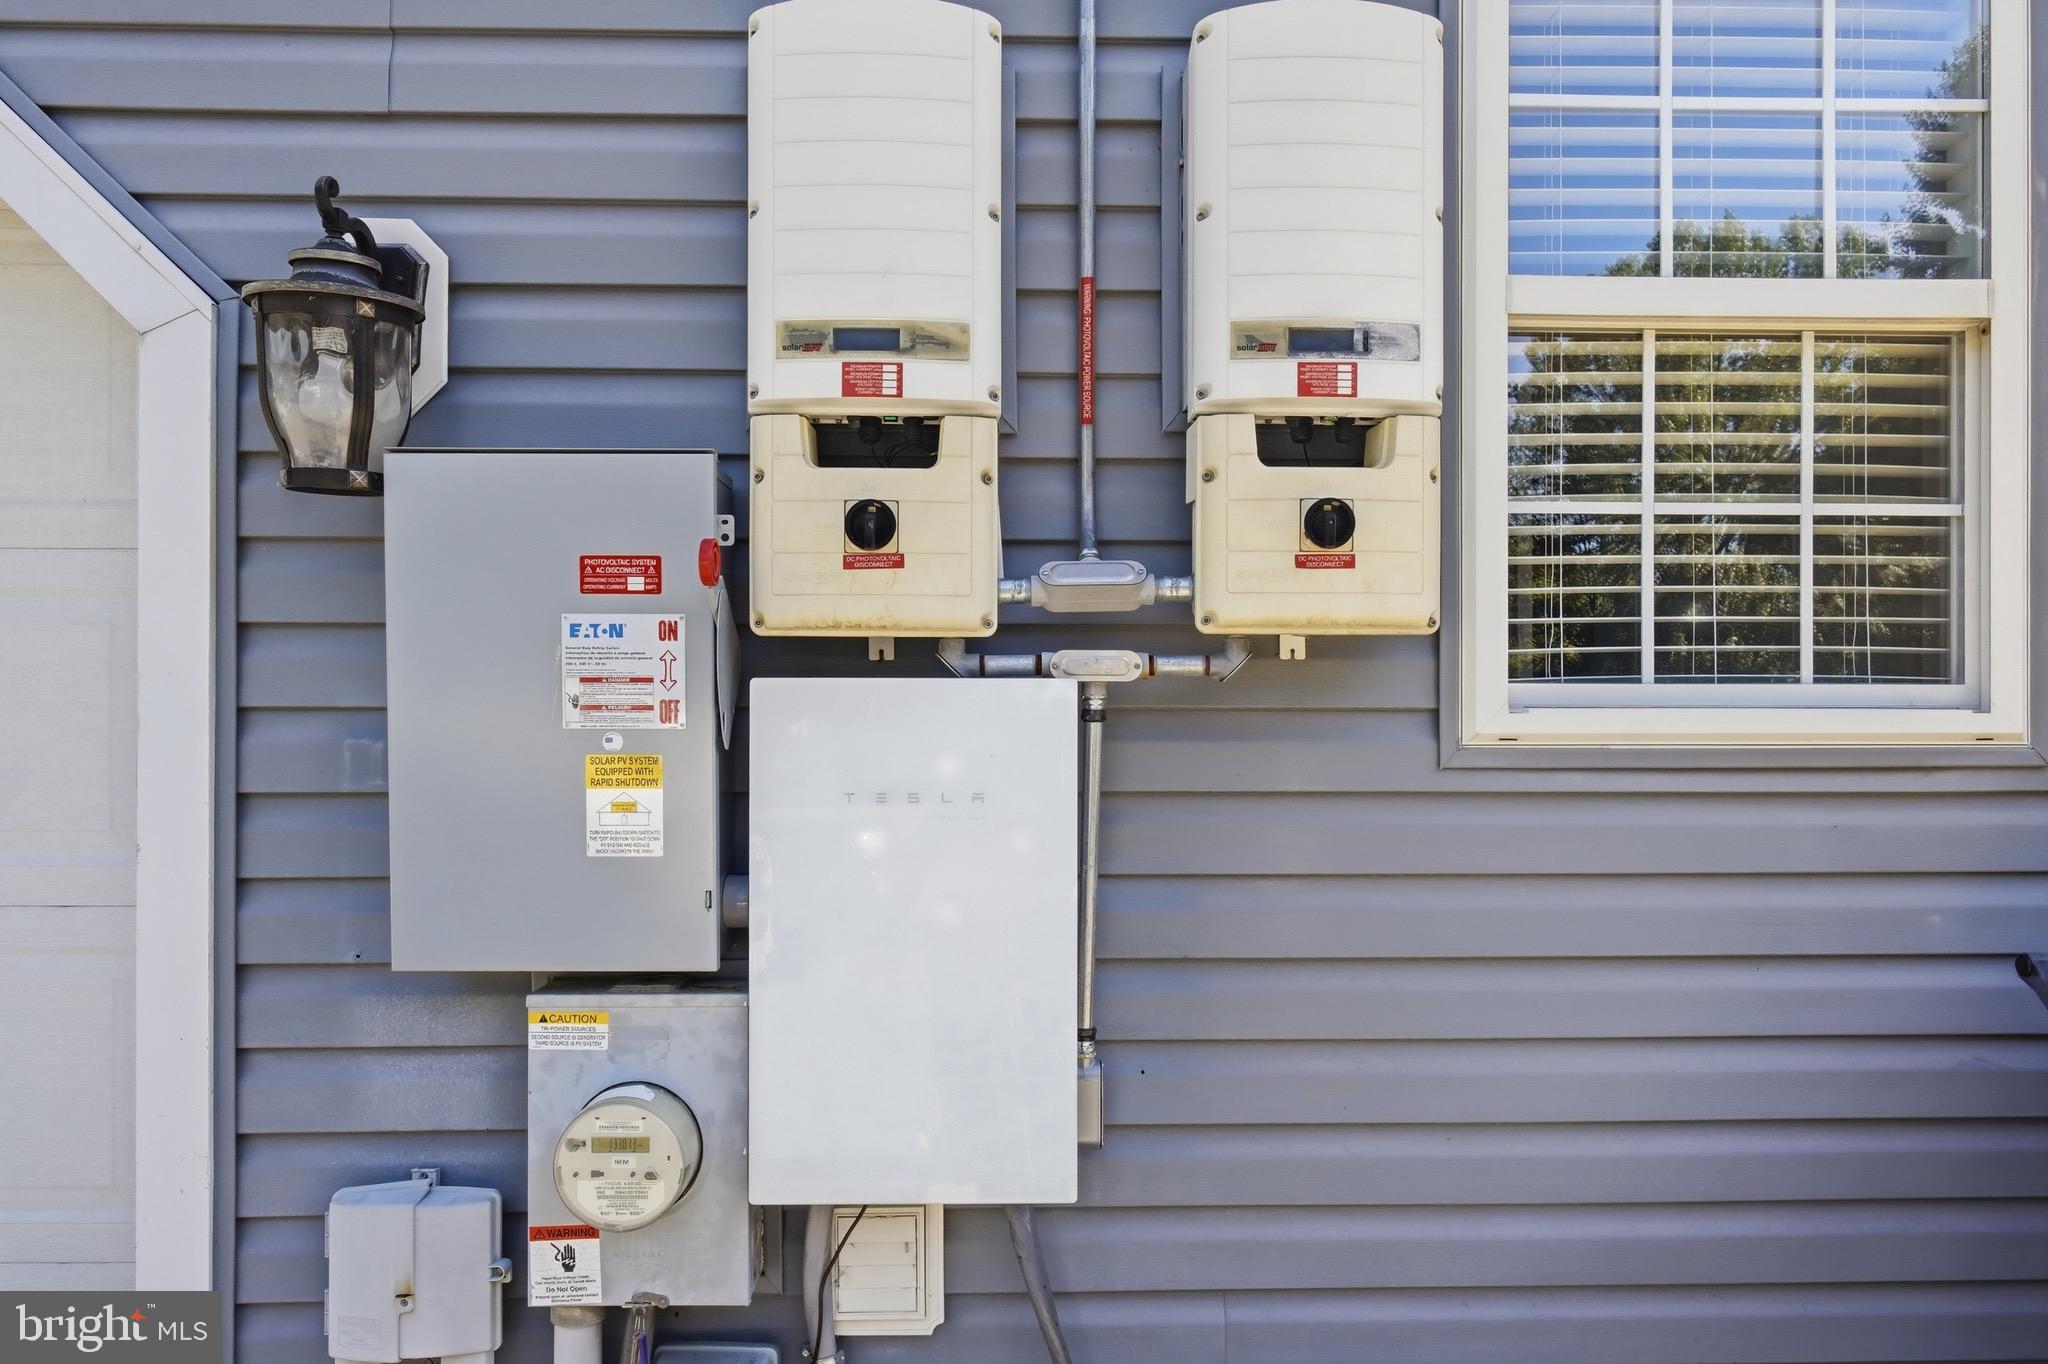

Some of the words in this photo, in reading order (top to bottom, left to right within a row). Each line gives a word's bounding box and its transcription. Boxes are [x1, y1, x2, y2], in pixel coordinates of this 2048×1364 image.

[1083, 283, 1092, 314] WARNING
[1083, 316, 1091, 366] PHOTOVOLTAIC
[1083, 366, 1091, 391] POWER
[1083, 391, 1091, 419] SOURCE
[658, 620, 678, 641] ON
[659, 699, 680, 724] OFF
[589, 756, 616, 765] SOLAR
[617, 756, 628, 765] PV
[628, 756, 659, 765] SYSTEM
[595, 767, 633, 776] EQUIPPED
[634, 767, 654, 776] WITH
[590, 778, 614, 787] RAPID
[615, 778, 659, 787] SHUTDOWN
[843, 792, 985, 804] TESLA
[549, 1014, 597, 1023] CAUTION
[547, 1227, 595, 1238] WARNING
[569, 1285, 588, 1293] Open
